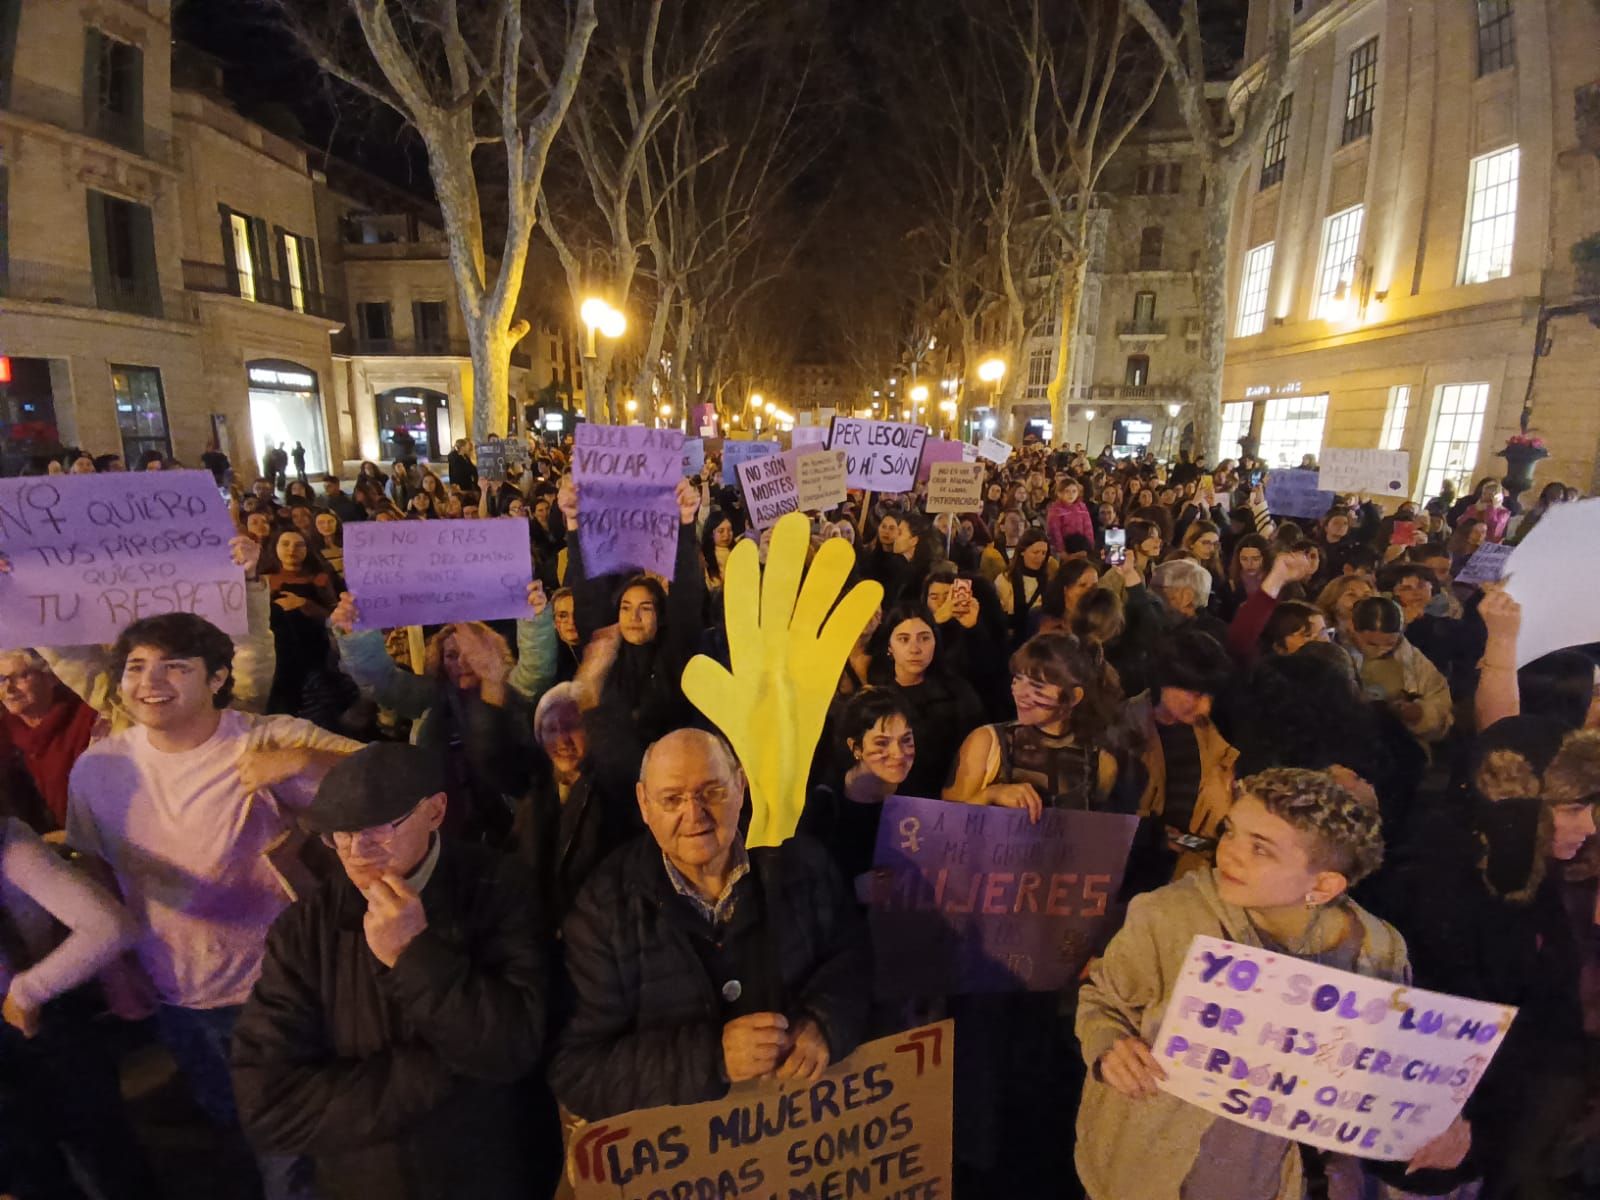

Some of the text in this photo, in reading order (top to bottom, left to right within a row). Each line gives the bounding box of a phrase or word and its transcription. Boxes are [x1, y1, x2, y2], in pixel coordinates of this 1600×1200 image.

[835, 424, 862, 445] PER
[745, 464, 762, 484] NO
[763, 456, 787, 479] SÓN
[751, 476, 795, 502] MORTES
[756, 495, 800, 524] ASSASSI
[392, 530, 418, 545] NO
[438, 528, 488, 545] ERES
[31, 543, 95, 566] TUS
[356, 551, 515, 569] PARTE DEL CAMINO
[362, 572, 406, 586] ERES
[27, 578, 244, 625] TU RESPETO
[932, 813, 945, 832] A
[943, 840, 970, 865] ME
[1200, 951, 1499, 1045] YO SOLO LUCHO
[1337, 1042, 1471, 1088] DERECHOS
[1313, 1085, 1378, 1113] QUE
[1390, 1100, 1431, 1124] TE
[606, 1062, 895, 1187] LAS MUJERES
[633, 1103, 914, 1200] RDAS SOMOS
[884, 1176, 942, 1200] TE
